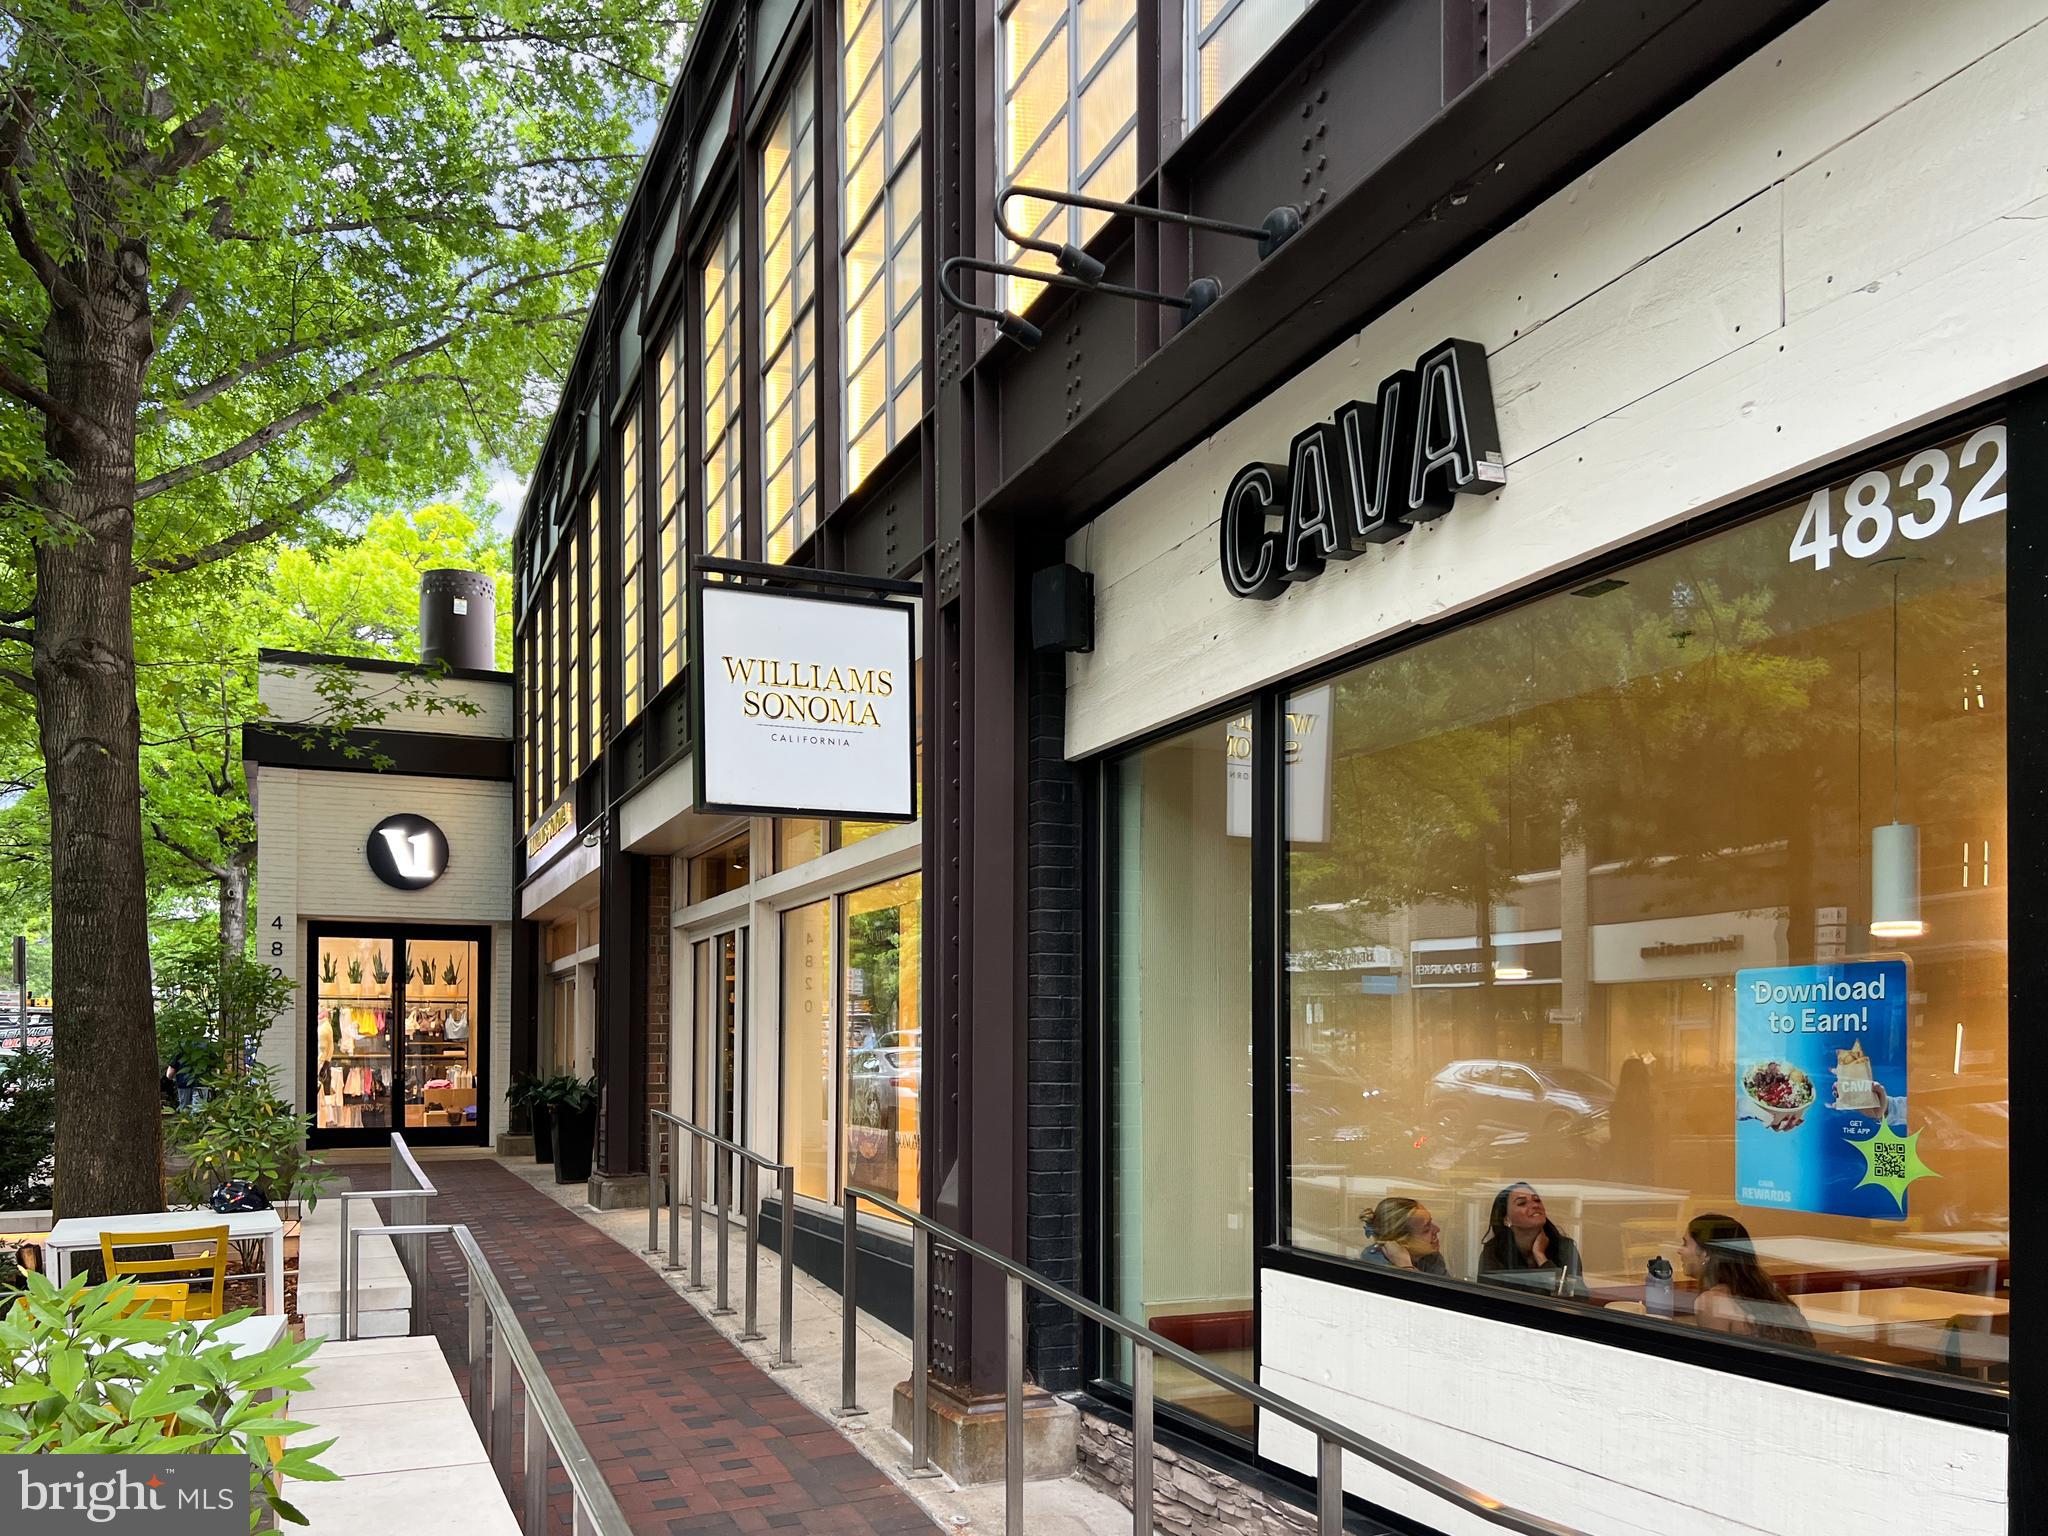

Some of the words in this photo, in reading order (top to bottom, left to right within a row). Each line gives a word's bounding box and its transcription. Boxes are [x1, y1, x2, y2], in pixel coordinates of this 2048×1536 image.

[1220, 338, 1505, 600] CAVA
[1789, 424, 2007, 570] 4832
[721, 655, 894, 697] WILLIAMS
[743, 691, 882, 728] SONOMA
[771, 733, 851, 747] CALIFORNIA
[1754, 973, 1885, 1005] Download
[1768, 1010, 1796, 1034] to
[1801, 1007, 1868, 1033] Earn!
[1841, 1080, 1873, 1093] CAVA
[1743, 1187, 1792, 1203] REWARDS
